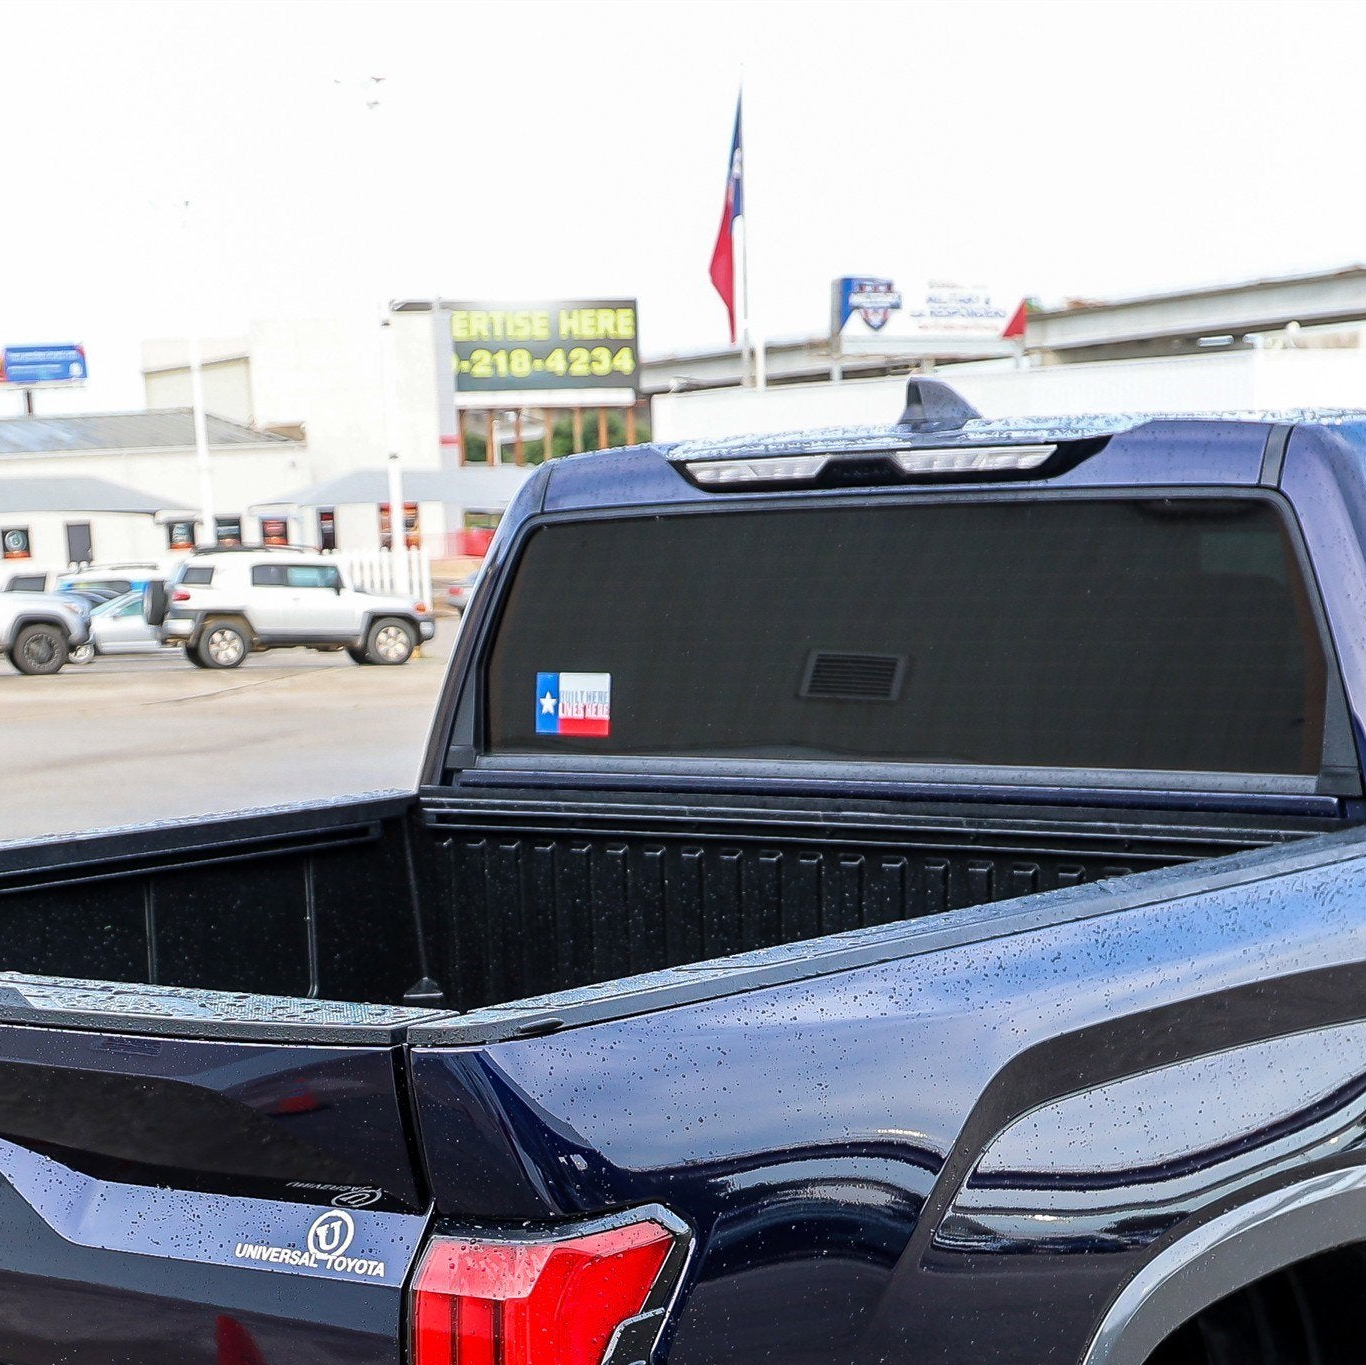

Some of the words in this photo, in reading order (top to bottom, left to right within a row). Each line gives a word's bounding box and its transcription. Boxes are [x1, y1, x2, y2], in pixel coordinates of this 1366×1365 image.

[558, 308, 635, 340] HERE
[235, 1242, 319, 1268] UNIVERSAL
[325, 1255, 386, 1278] TOYOTA
